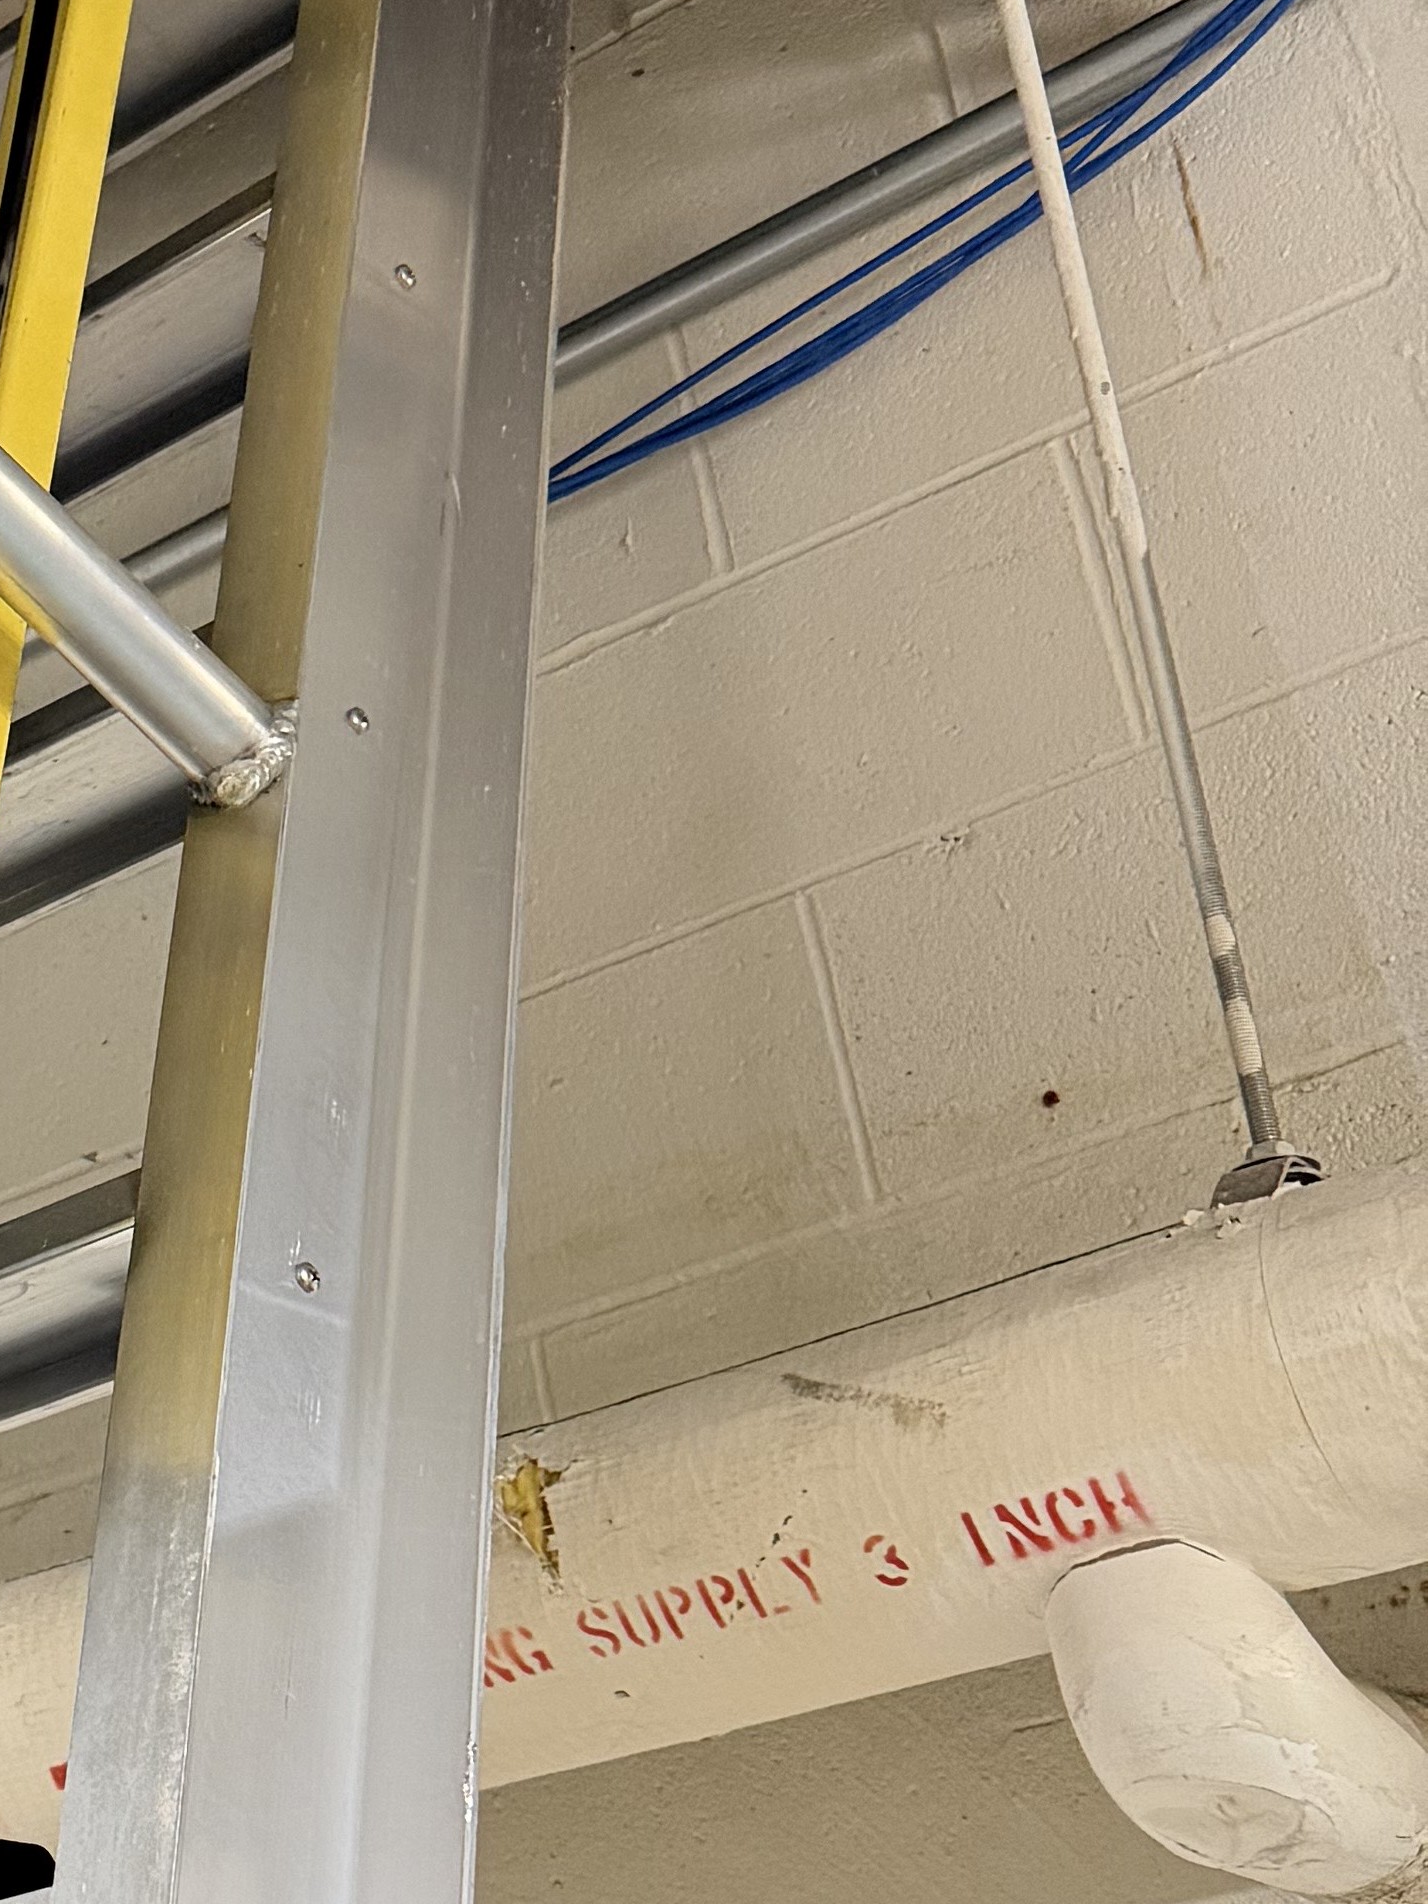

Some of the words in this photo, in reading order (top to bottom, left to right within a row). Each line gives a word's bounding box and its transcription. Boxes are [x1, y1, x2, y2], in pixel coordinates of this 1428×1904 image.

[576, 1548, 820, 1658] SUPPLY
[863, 1534, 909, 1587] 3
[959, 1470, 1152, 1568] INCH
